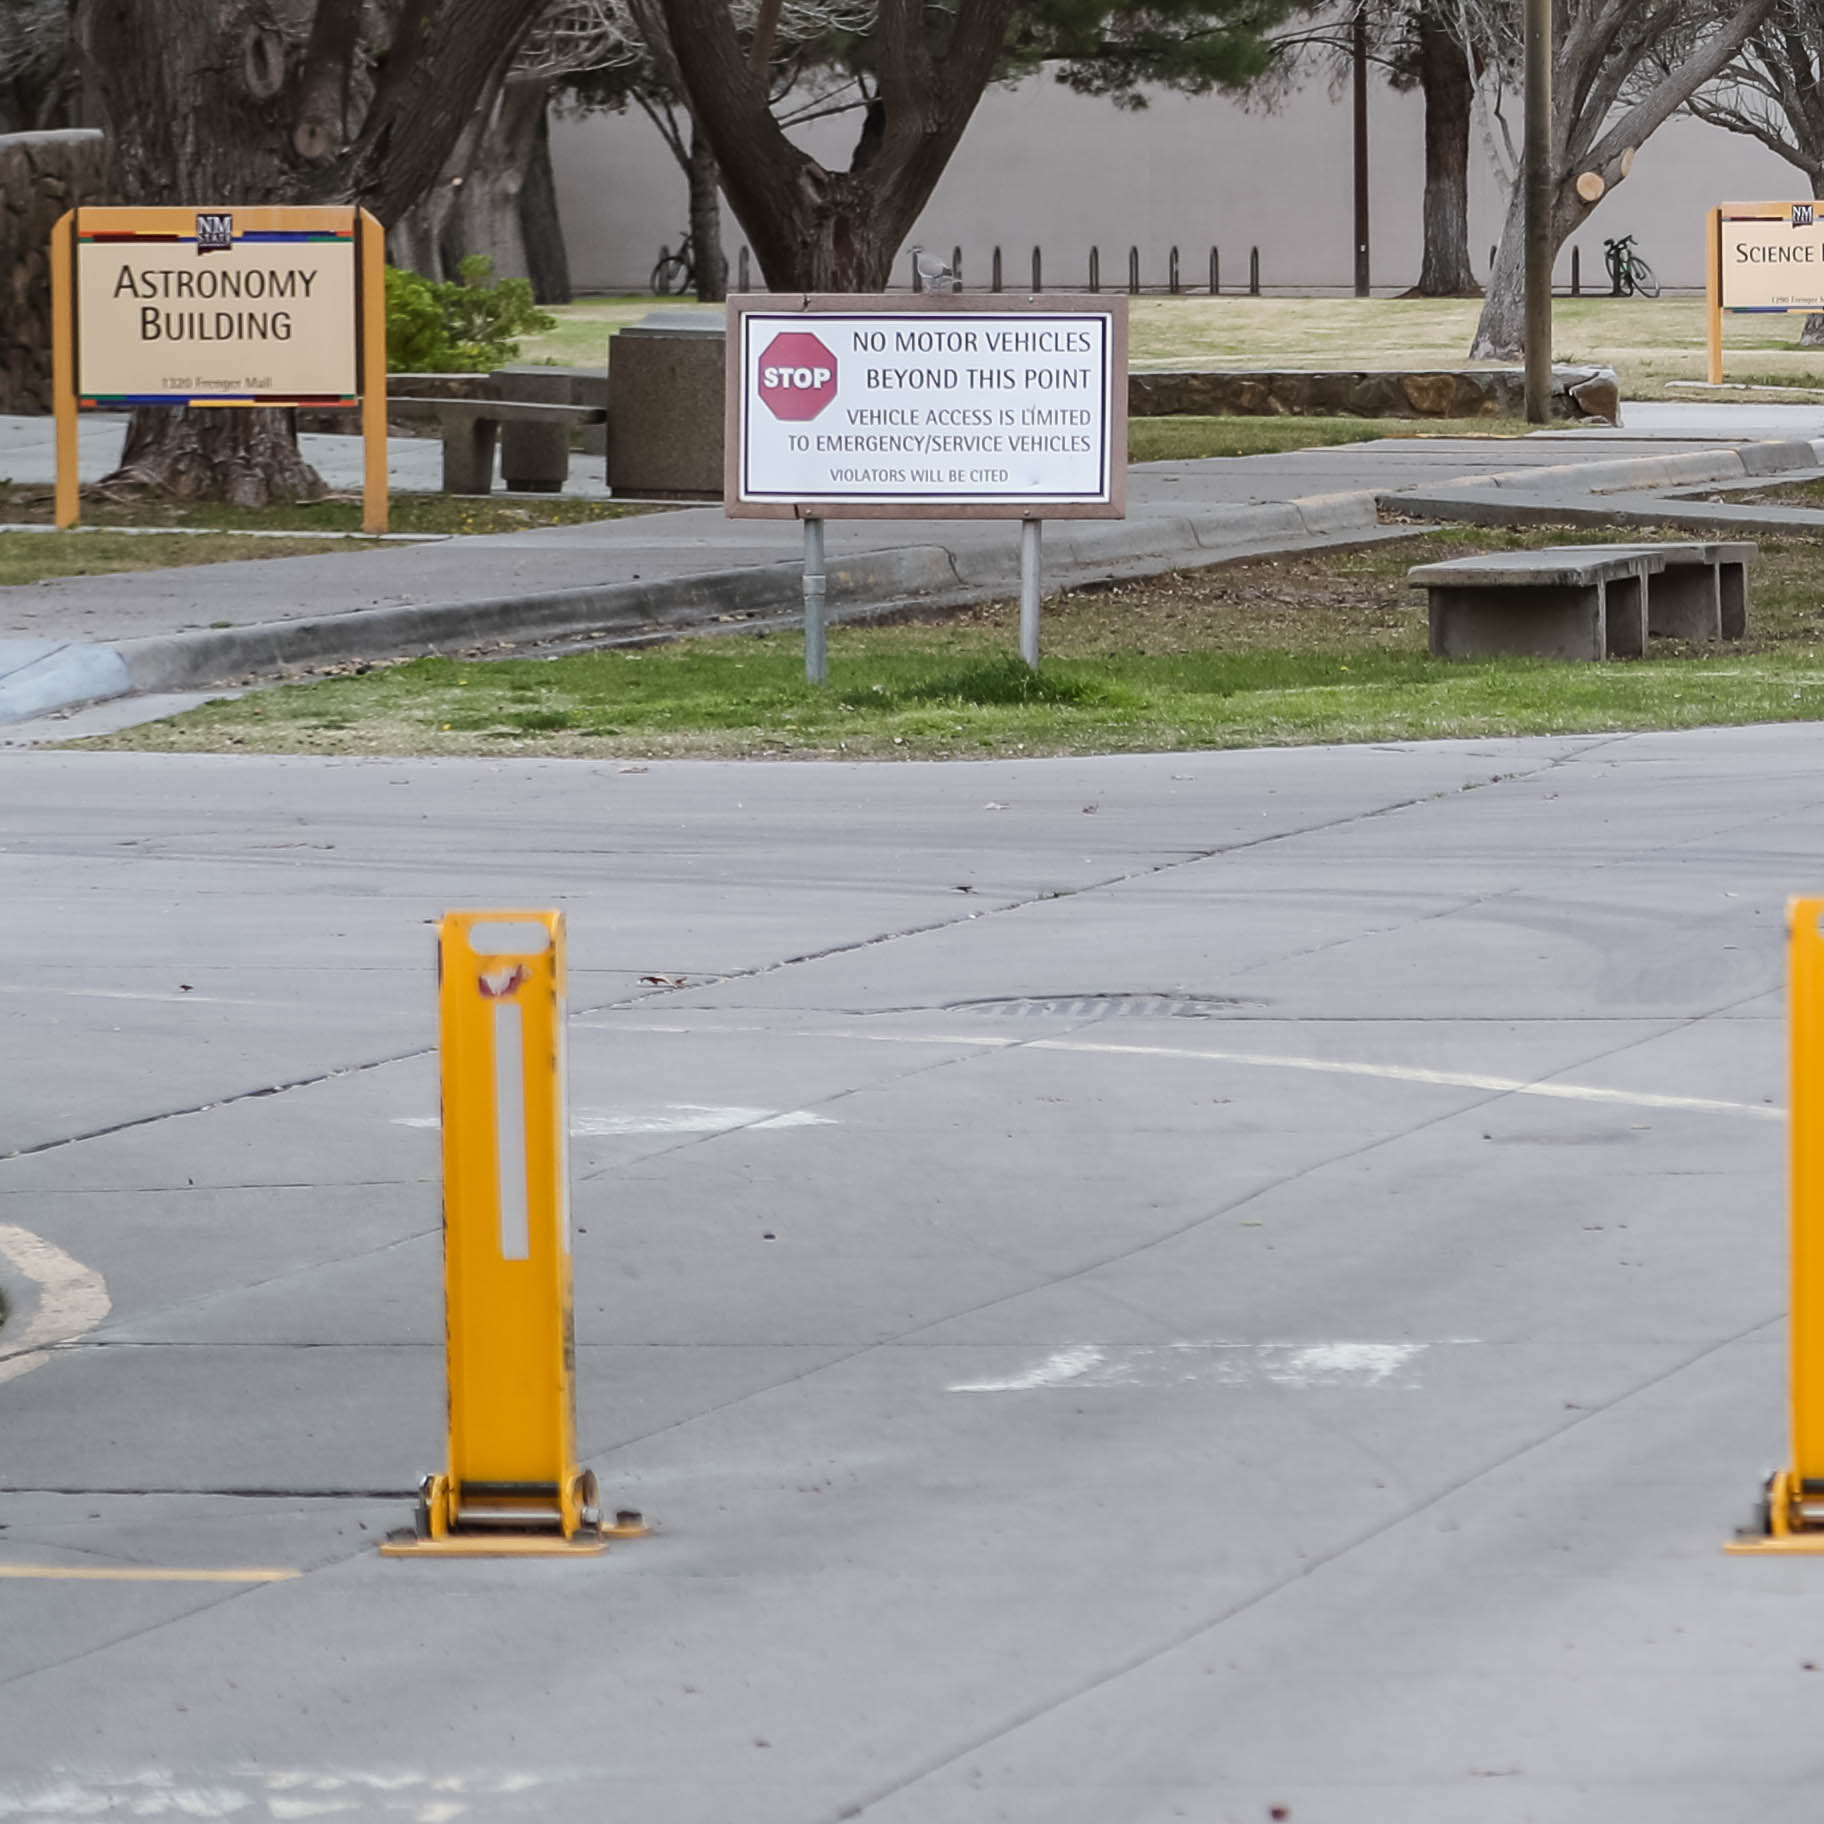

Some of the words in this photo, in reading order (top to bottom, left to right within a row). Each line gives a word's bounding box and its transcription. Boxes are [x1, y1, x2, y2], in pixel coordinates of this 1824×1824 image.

[197, 216, 232, 233] NM
[1735, 242, 1815, 263] SCIENCE
[113, 264, 319, 299] ASTRONOMY
[140, 306, 292, 341] BUILDING
[852, 331, 886, 353] NO
[895, 331, 978, 353] MOTOR
[985, 331, 1092, 353] VEHICLES
[763, 366, 832, 390] STOP
[866, 368, 958, 390] BEYOND
[966, 368, 1016, 390] THIS
[1025, 368, 1092, 390] POINT
[846, 408, 920, 426] VEHICLE
[925, 408, 993, 426] ACCESS
[999, 408, 1015, 426] IS
[1021, 408, 1091, 426] LIMITED
[788, 434, 810, 452] TO
[816, 434, 1003, 454] EMERGENCY/SERVICE
[1008, 434, 1091, 452] VEHICLES
[829, 468, 906, 483] VIOLATORS
[910, 468, 944, 483] WILL
[949, 468, 966, 483] BE
[970, 468, 1009, 483] CITED
